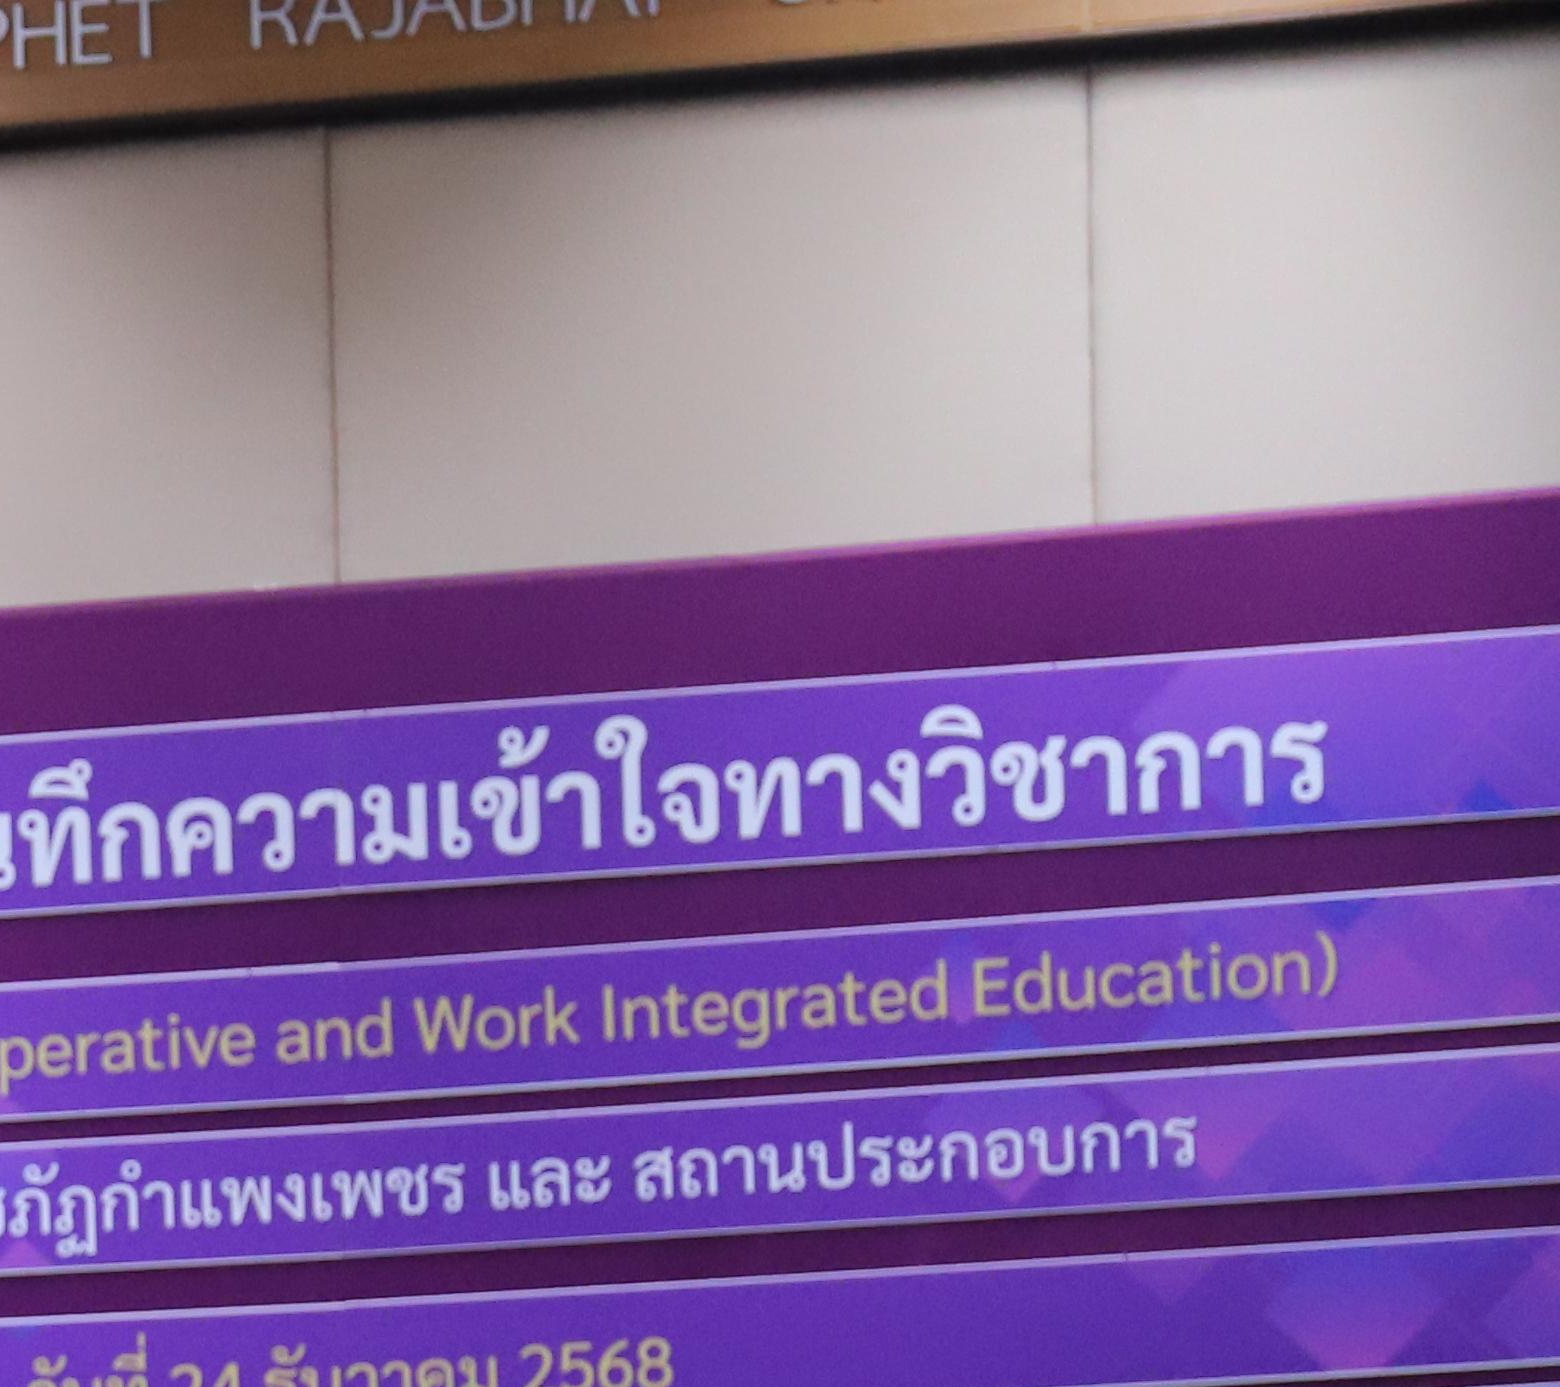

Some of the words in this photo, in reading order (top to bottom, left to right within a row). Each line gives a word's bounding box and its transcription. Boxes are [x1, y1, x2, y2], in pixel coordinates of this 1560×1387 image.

[275, 997, 395, 1065] and
[412, 984, 581, 1055] Work
[601, 957, 949, 1051] Integrated
[971, 929, 1340, 1018] Education)
[487, 1151, 613, 1211] และ
[632, 1113, 1198, 1203] สถานประกอบการ
